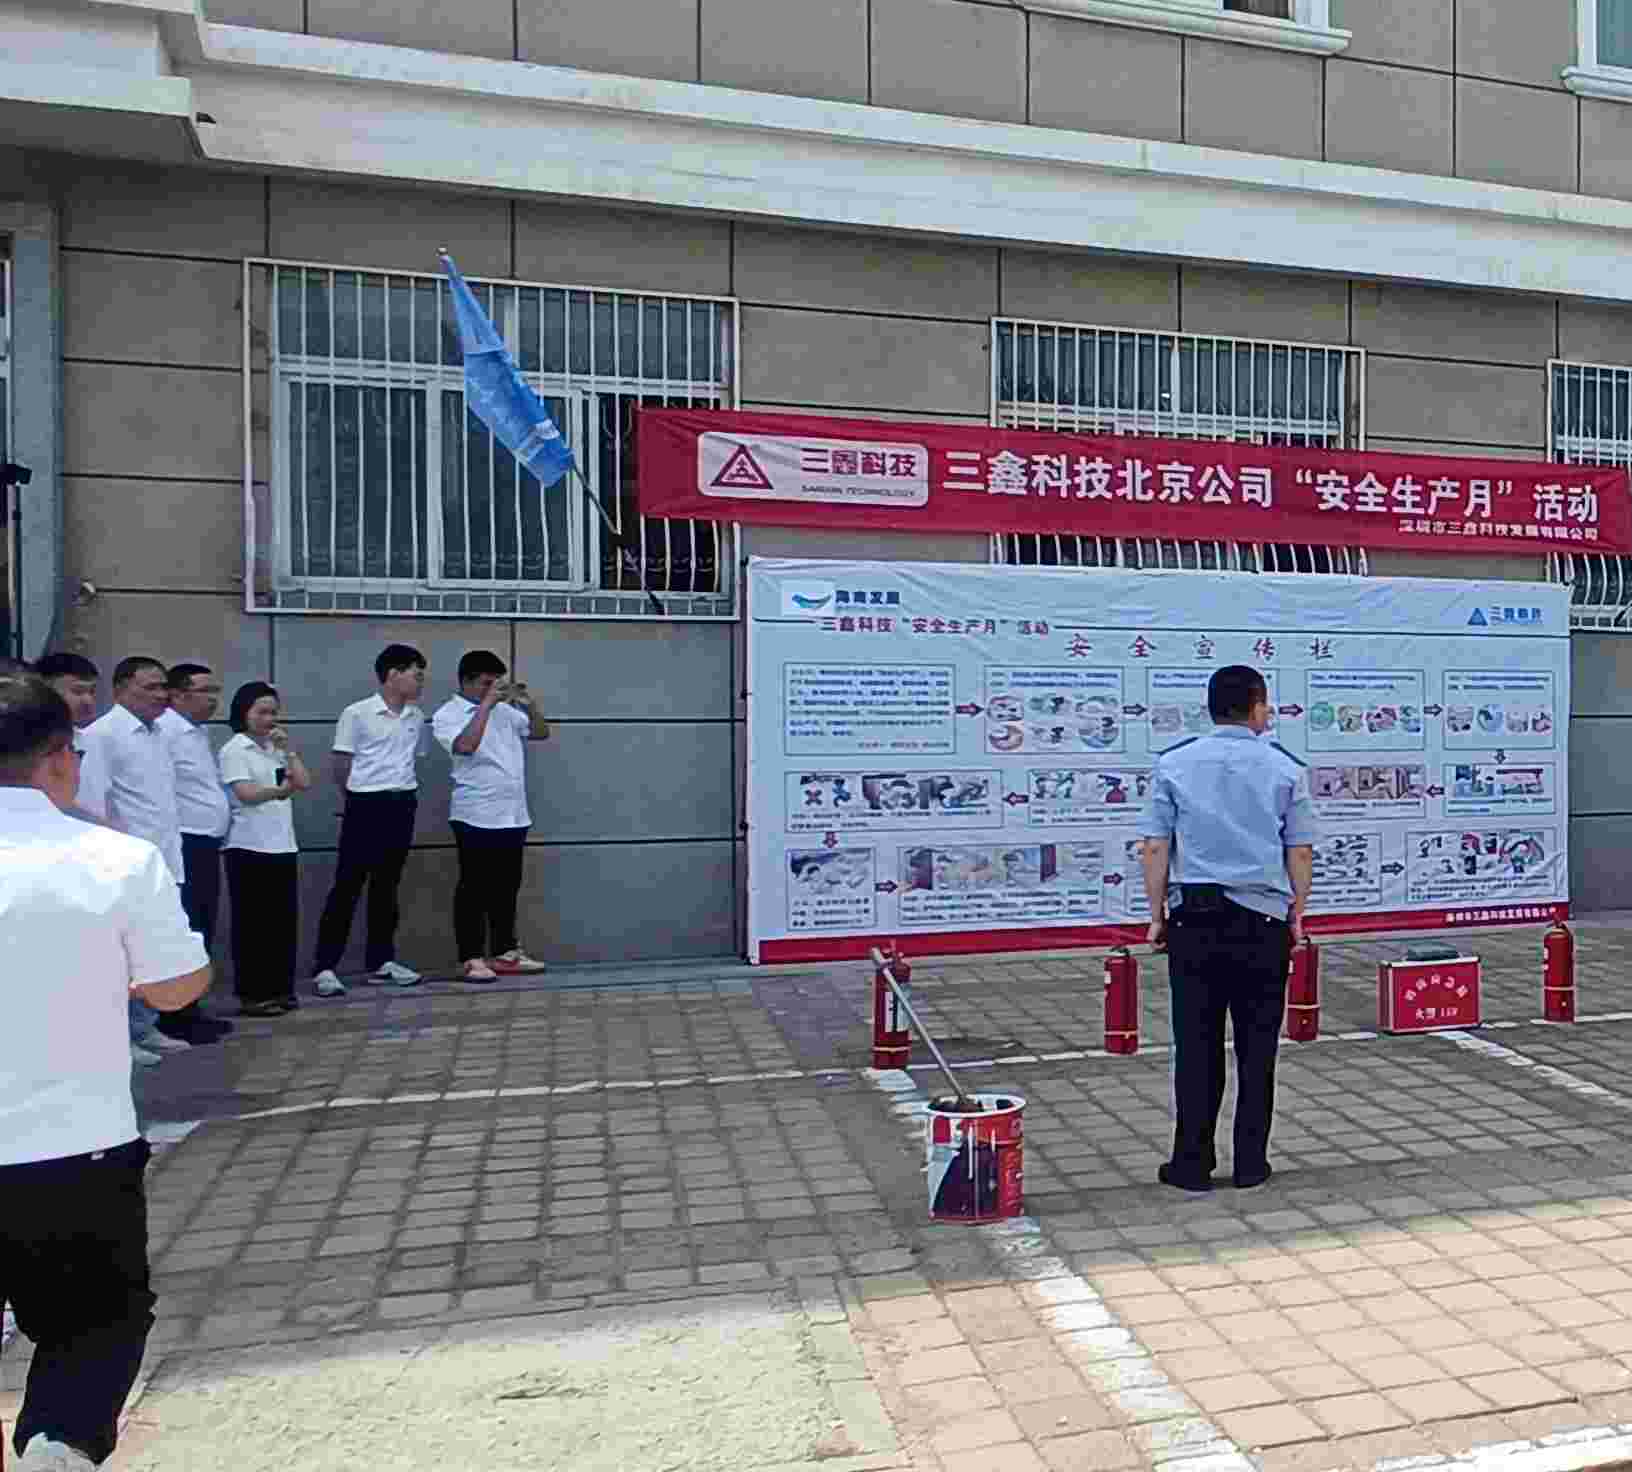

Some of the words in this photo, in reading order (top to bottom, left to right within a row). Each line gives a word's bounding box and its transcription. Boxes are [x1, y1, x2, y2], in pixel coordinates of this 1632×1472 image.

[801, 447, 916, 477] 三鑫科技
[1065, 633, 1334, 661] 安全宣传栏
